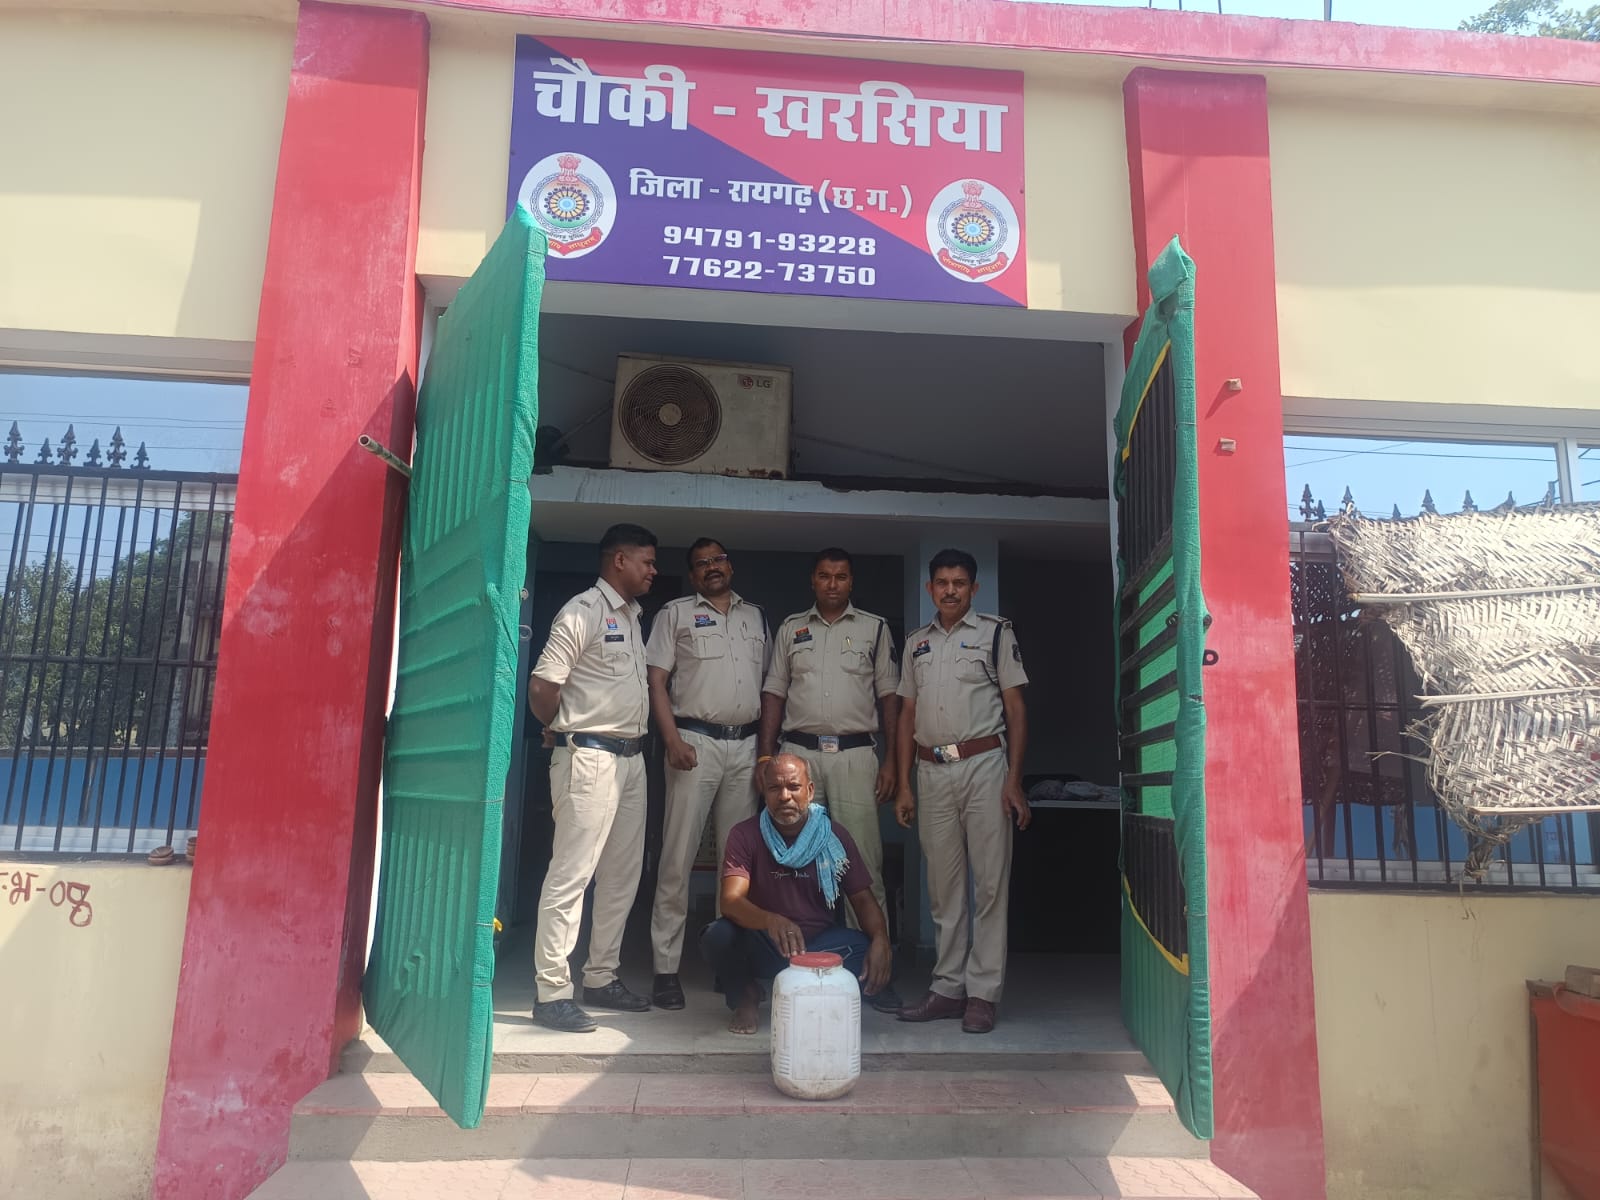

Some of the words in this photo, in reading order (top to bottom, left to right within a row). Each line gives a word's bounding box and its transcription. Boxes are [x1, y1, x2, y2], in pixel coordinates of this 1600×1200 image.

[532, 56, 697, 131] चौकी
[755, 80, 1009, 153] खरसिया
[628, 168, 704, 200] जिला
[662, 225, 876, 256] 94791-93228
[662, 255, 876, 286] 77622-73750
[756, 380, 771, 388] LG
